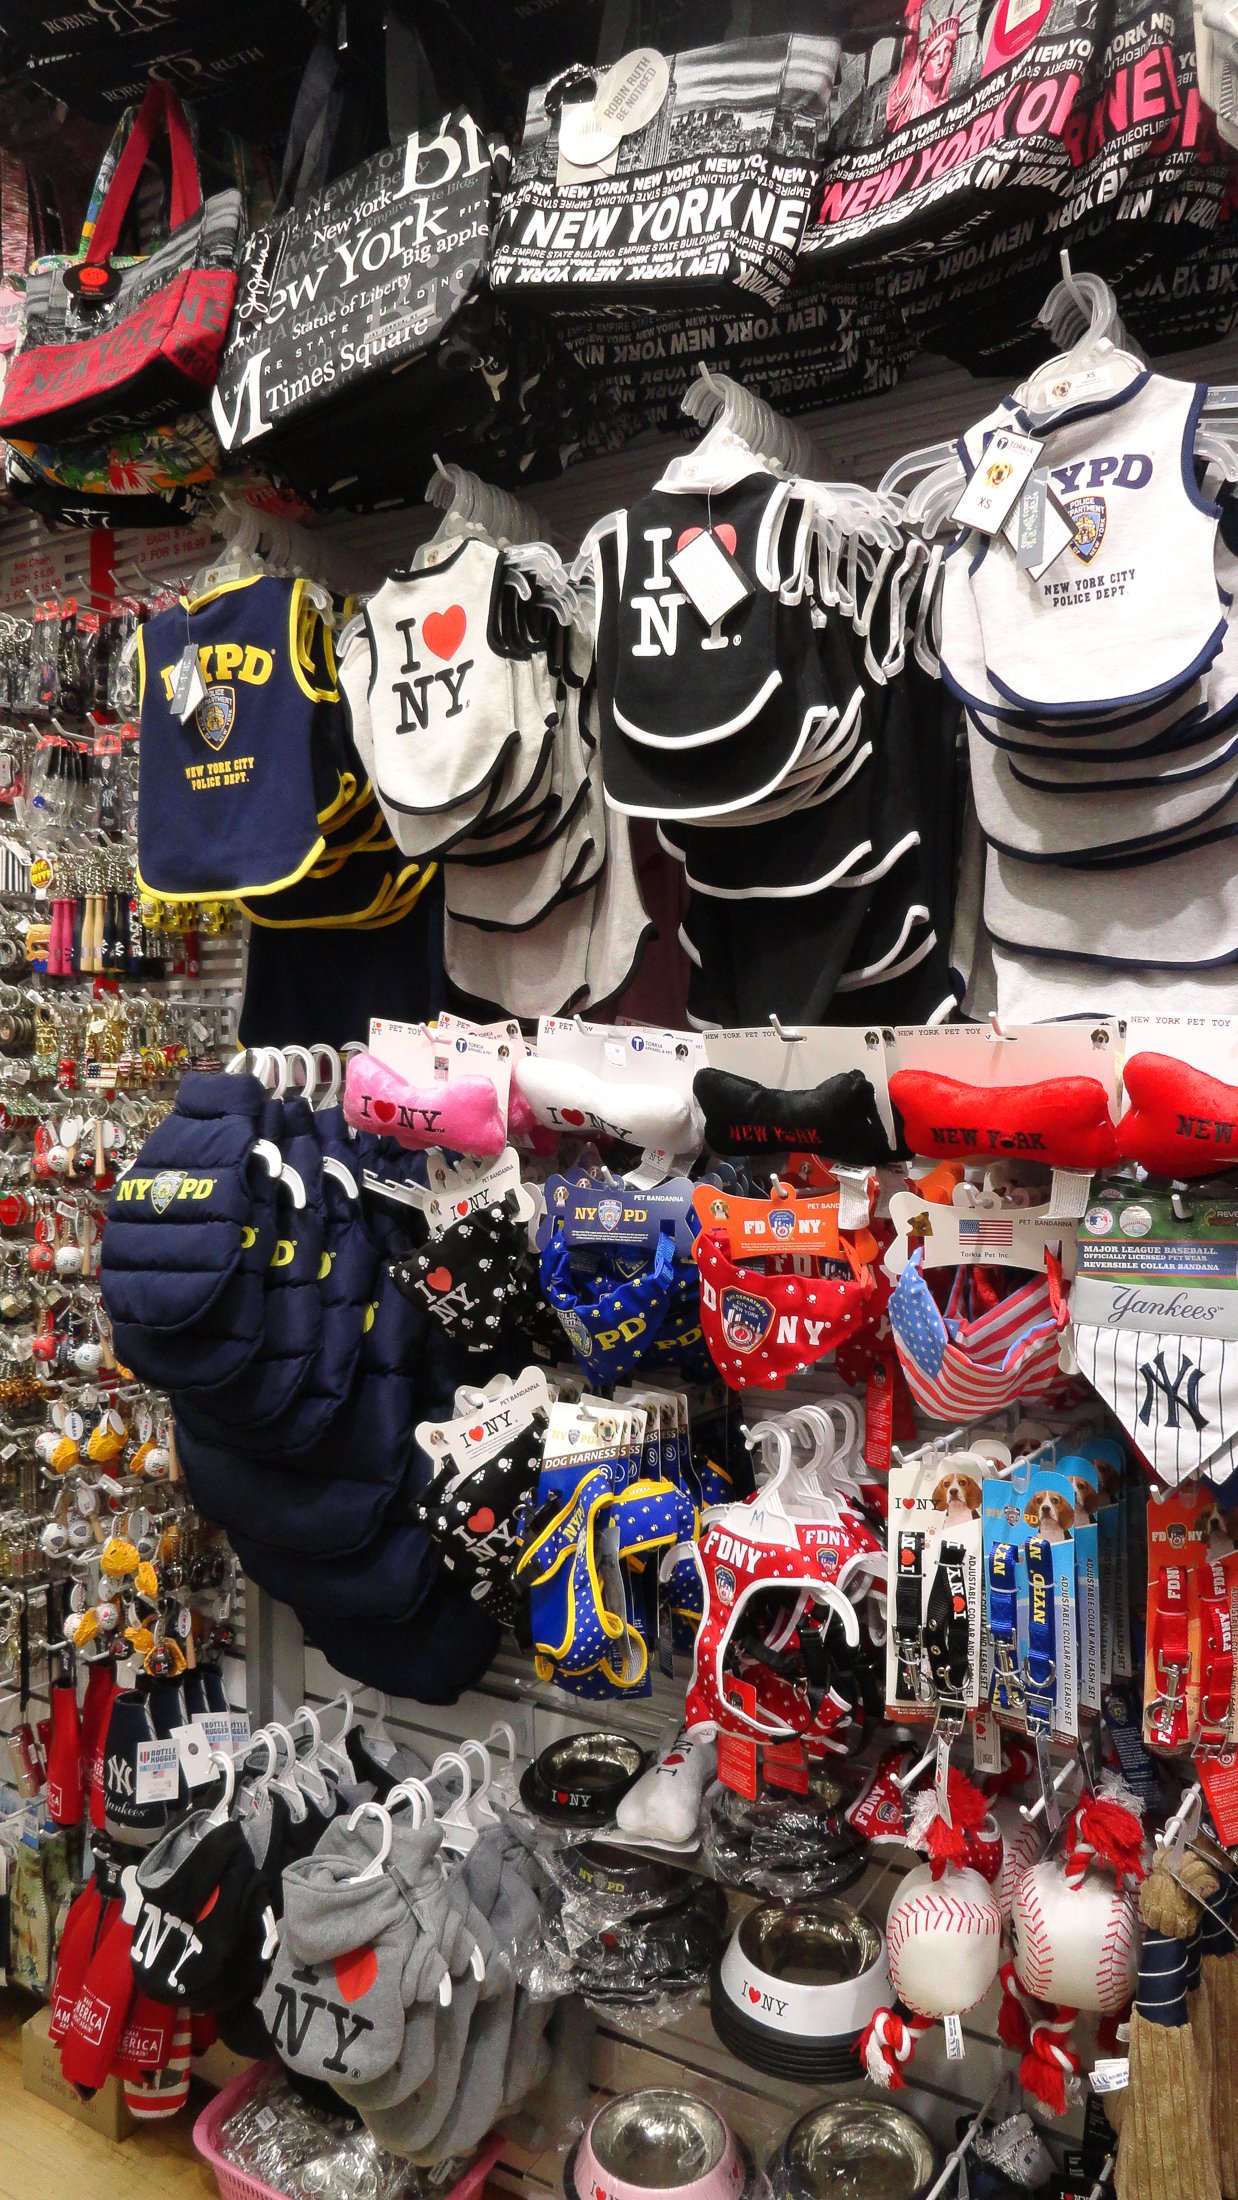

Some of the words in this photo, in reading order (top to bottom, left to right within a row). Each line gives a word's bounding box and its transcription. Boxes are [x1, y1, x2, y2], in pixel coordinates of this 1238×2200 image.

[41, 11, 99, 34] ROBIN
[210, 47, 266, 72] RUTH
[603, 84, 630, 119] ROBIN
[626, 56, 651, 86] RUTH
[615, 106, 630, 122] BE
[625, 67, 657, 108] NOTICED
[852, 149, 886, 170] YORK
[885, 131, 910, 157] NEW
[911, 112, 944, 140] YORK
[945, 97, 975, 123] NEW
[975, 72, 1007, 106] YORK
[818, 156, 913, 224] NEW
[912, 84, 1020, 189] YORK
[558, 184, 593, 198] NEW
[593, 180, 629, 197] YORK
[633, 170, 664, 191] NEW
[665, 161, 701, 184] YORK
[705, 158, 741, 173] NEW
[311, 217, 352, 249] New
[353, 189, 394, 226] York
[520, 206, 623, 250] NEW
[628, 183, 743, 244] YORK
[335, 198, 449, 287] York
[402, 244, 431, 268] Big
[437, 221, 489, 253] apple
[512, 247, 546, 258] EMPIRE
[546, 250, 574, 259] STATE
[573, 249, 616, 259] BUILDING
[618, 244, 651, 257] EMPIRE
[652, 239, 680, 251] STATE
[680, 232, 720, 248] BUILDING
[292, 311, 337, 341] Statue
[340, 294, 358, 316] of
[359, 272, 411, 309] Liberty
[295, 323, 349, 358] STATE
[366, 270, 464, 324] BUILDING
[265, 360, 336, 412] Times
[340, 318, 428, 372] Square
[1051, 453, 1153, 495] YPD
[976, 495, 993, 511] XS
[643, 527, 672, 590] I
[1043, 582, 1070, 597] NEW
[1075, 576, 1105, 592] YORK
[1110, 569, 1136, 585] CITY
[1053, 592, 1091, 608] POLICE
[395, 617, 421, 674] I
[391, 659, 474, 735] NY
[185, 767, 203, 780] NEW
[206, 761, 231, 777] YORK
[233, 757, 255, 771] CITY
[191, 777, 220, 791] POLICE
[388, 1024, 402, 1033] PET
[407, 1027, 422, 1036] TOY
[558, 1022, 573, 1031] PET
[918, 1029, 940, 1037] YORK
[944, 1028, 963, 1036] PET
[966, 1028, 982, 1036] TOY
[1130, 1015, 1151, 1024] NEW
[1155, 1016, 1181, 1025] YORK
[1187, 1018, 1206, 1027] PET
[1211, 1019, 1231, 1027] TOY
[705, 1033, 719, 1041] NEW
[722, 1032, 741, 1040] YORK
[361, 1095, 372, 1118] I
[397, 1104, 443, 1133] NY
[546, 1106, 563, 1125] I
[584, 1111, 633, 1140] NY
[728, 1124, 768, 1143] NEW
[932, 1126, 979, 1147] NEW
[1175, 1114, 1236, 1145] NEW
[116, 1179, 155, 1201] NY
[177, 1178, 214, 1200] PD
[634, 1194, 646, 1202] PET
[647, 1195, 684, 1203] BANDANNA
[450, 1206, 459, 1221] I
[468, 1188, 491, 1212] NY
[574, 1207, 598, 1220] NY
[623, 1209, 648, 1223] PD
[743, 1220, 766, 1235] FD
[798, 1219, 822, 1234] NY
[1034, 1220, 1073, 1228] BANDANNA
[960, 1251, 982, 1259] Torkia
[984, 1251, 996, 1259] Pet
[1083, 1245, 1119, 1254] MAJOR
[1121, 1246, 1161, 1254] LEAGUE
[1083, 1261, 1138, 1269] REVERSIBLE
[1140, 1262, 1176, 1270] COLLAR
[1177, 1263, 1220, 1271] BANDANA
[428, 1282, 475, 1325] NY
[1107, 1284, 1219, 1324] Yankees
[595, 1316, 647, 1351] PD
[776, 1315, 825, 1345] NY
[1138, 1351, 1210, 1432] NY
[459, 1433, 471, 1449] I
[484, 1409, 514, 1438] NY
[551, 1431, 567, 1441] NY
[580, 1434, 596, 1445] PD
[544, 1456, 568, 1470] DOG
[569, 1447, 617, 1465] HARNESS
[895, 1498, 902, 1510] I
[916, 1498, 939, 1511] NY
[1022, 1513, 1039, 1524] PD
[750, 1509, 765, 1533] M
[805, 1529, 850, 1548] FDNY
[1152, 1531, 1166, 1542] FD
[1188, 1530, 1203, 1542] NY
[704, 1530, 763, 1575] FDNY
[968, 1555, 976, 1605] ADJUSTABLE
[1086, 1557, 1095, 1607] ADJUSTABLE
[1033, 1573, 1046, 1625] NYPD
[1061, 1576, 1071, 1627] ADJUSTABLE
[1087, 1608, 1096, 1639] COLLAR
[1219, 1611, 1232, 1652] FDNY
[1062, 1629, 1071, 1662] COLLAR
[1088, 1640, 1096, 1657] AND
[1063, 1663, 1072, 1681] AND
[1088, 1658, 1096, 1687] LEASH
[1063, 1682, 1072, 1713] LEASH
[1087, 1688, 1096, 1700] SET
[1064, 1714, 1072, 1726] SET
[150, 1747, 177, 1757] BOTTLE
[150, 1755, 177, 1764] HUGGER
[551, 1790, 557, 1803] I
[569, 1793, 591, 1807] NY
[854, 1785, 886, 1828] FDNY
[607, 1881, 625, 1893] PD
[131, 1903, 202, 1988] NY
[742, 1980, 749, 1998] I
[761, 1996, 789, 2017] NY
[270, 1982, 375, 2074] NY
